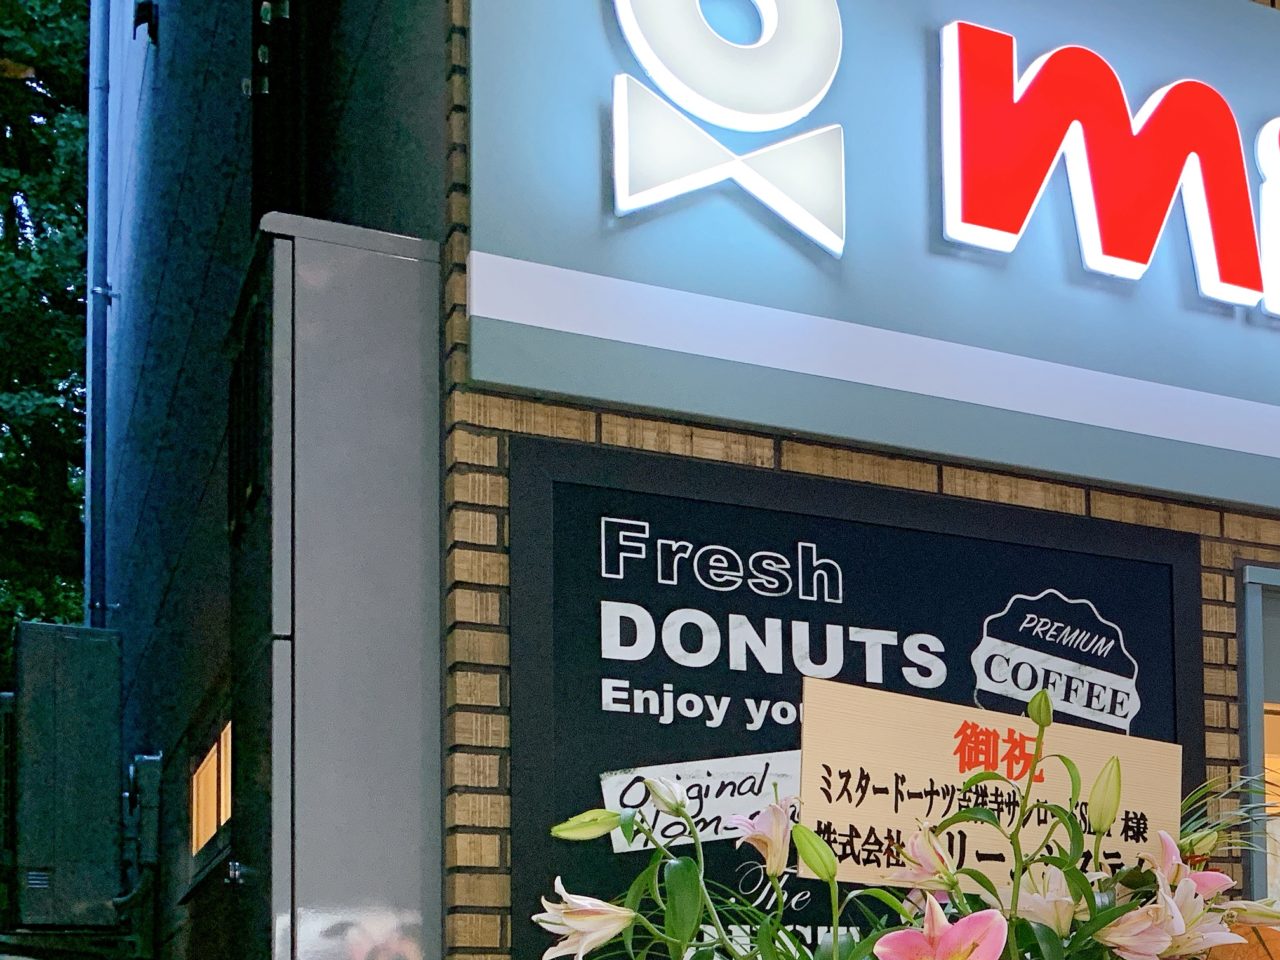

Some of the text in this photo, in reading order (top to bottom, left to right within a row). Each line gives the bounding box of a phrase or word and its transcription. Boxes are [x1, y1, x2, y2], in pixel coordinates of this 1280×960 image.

[600, 516, 843, 604] Fresh
[600, 600, 948, 689] DONUTS
[1018, 613, 1115, 658] PREMIUM
[601, 677, 803, 731] Enjoy yo
[984, 653, 1131, 720] COFFEE
[953, 720, 1045, 783] 御祝
[1120, 809, 1150, 844] 様
